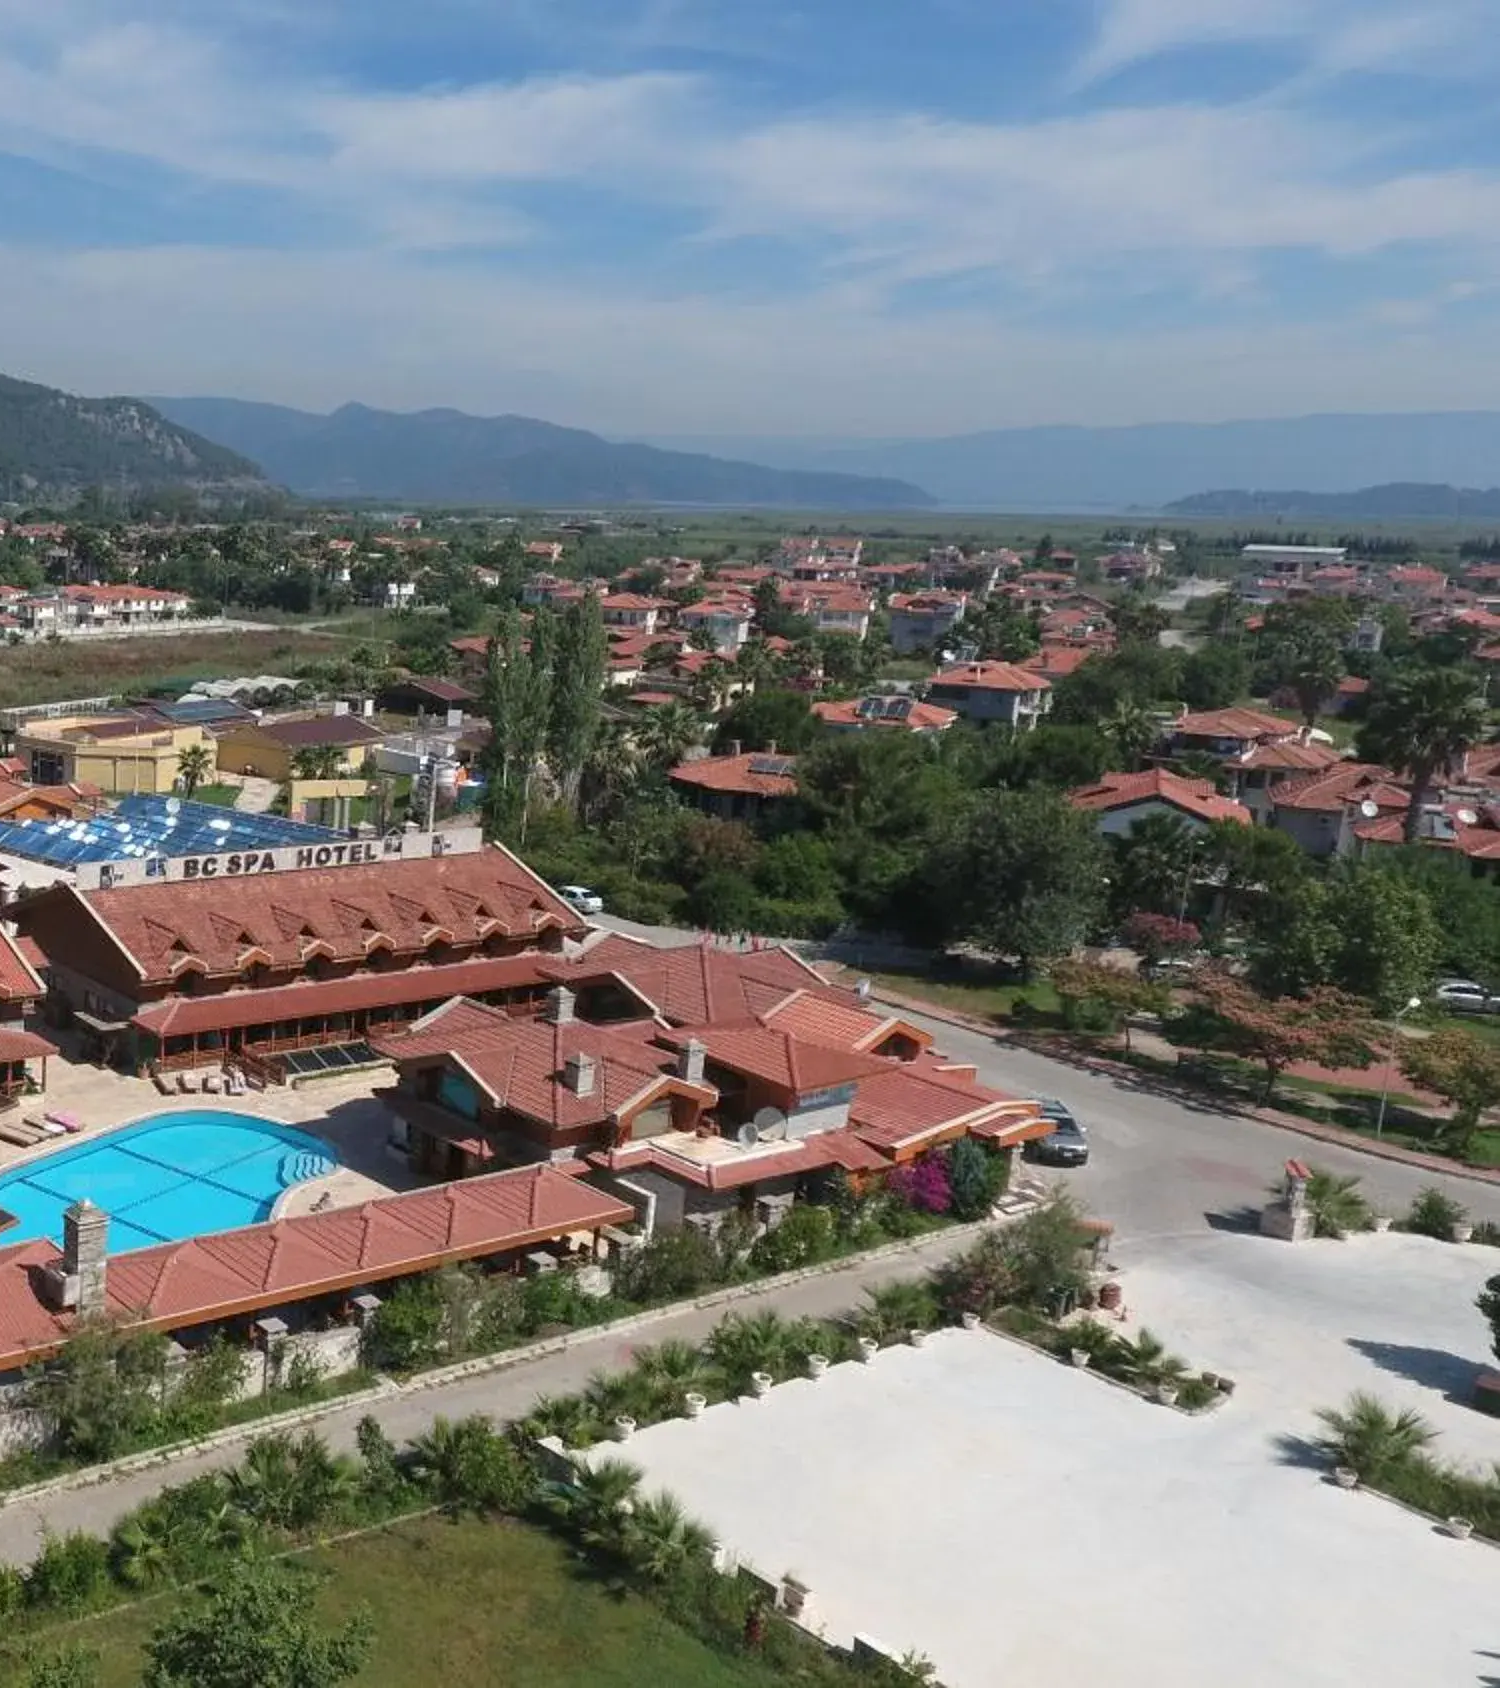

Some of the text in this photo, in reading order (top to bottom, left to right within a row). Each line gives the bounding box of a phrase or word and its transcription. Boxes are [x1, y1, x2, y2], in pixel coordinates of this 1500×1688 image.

[183, 843, 377, 878] BC SPA HOTEL
